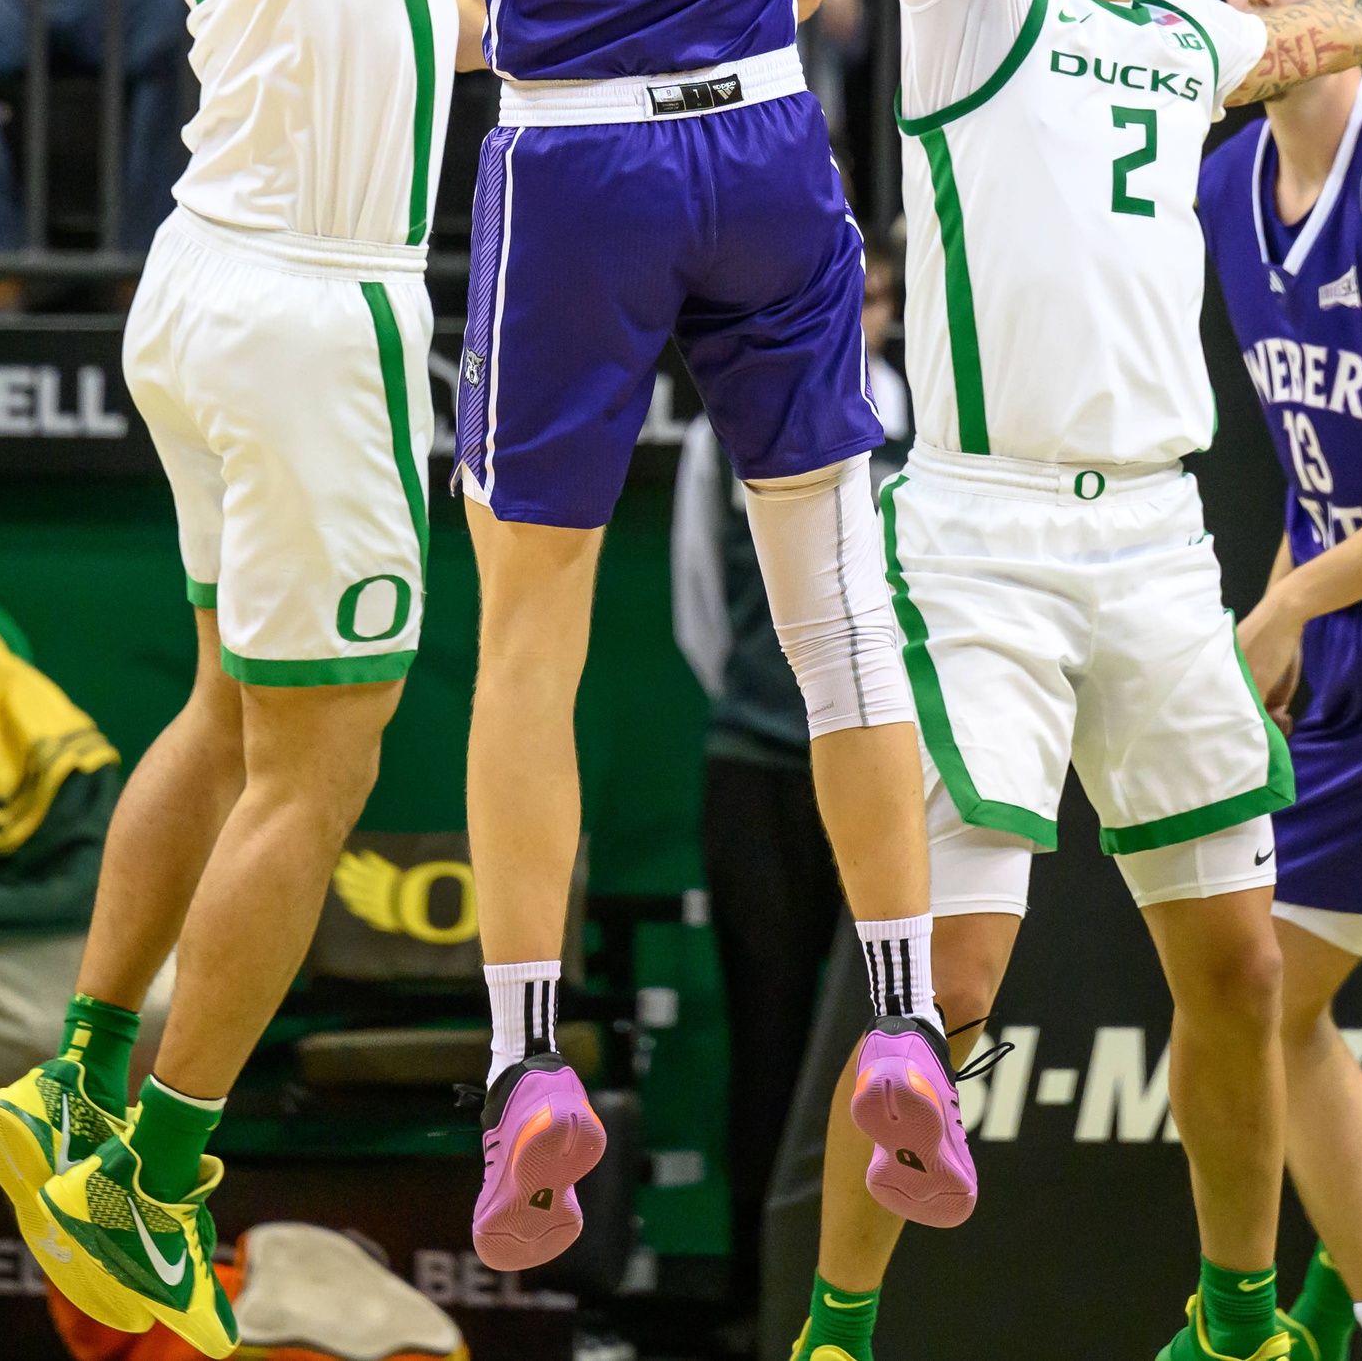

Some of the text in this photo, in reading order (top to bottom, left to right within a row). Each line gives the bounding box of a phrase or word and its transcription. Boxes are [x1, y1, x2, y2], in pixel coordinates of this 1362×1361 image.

[1049, 50, 1203, 102] DUCKS
[1110, 104, 1158, 218] 2
[1282, 409, 1335, 494] 13
